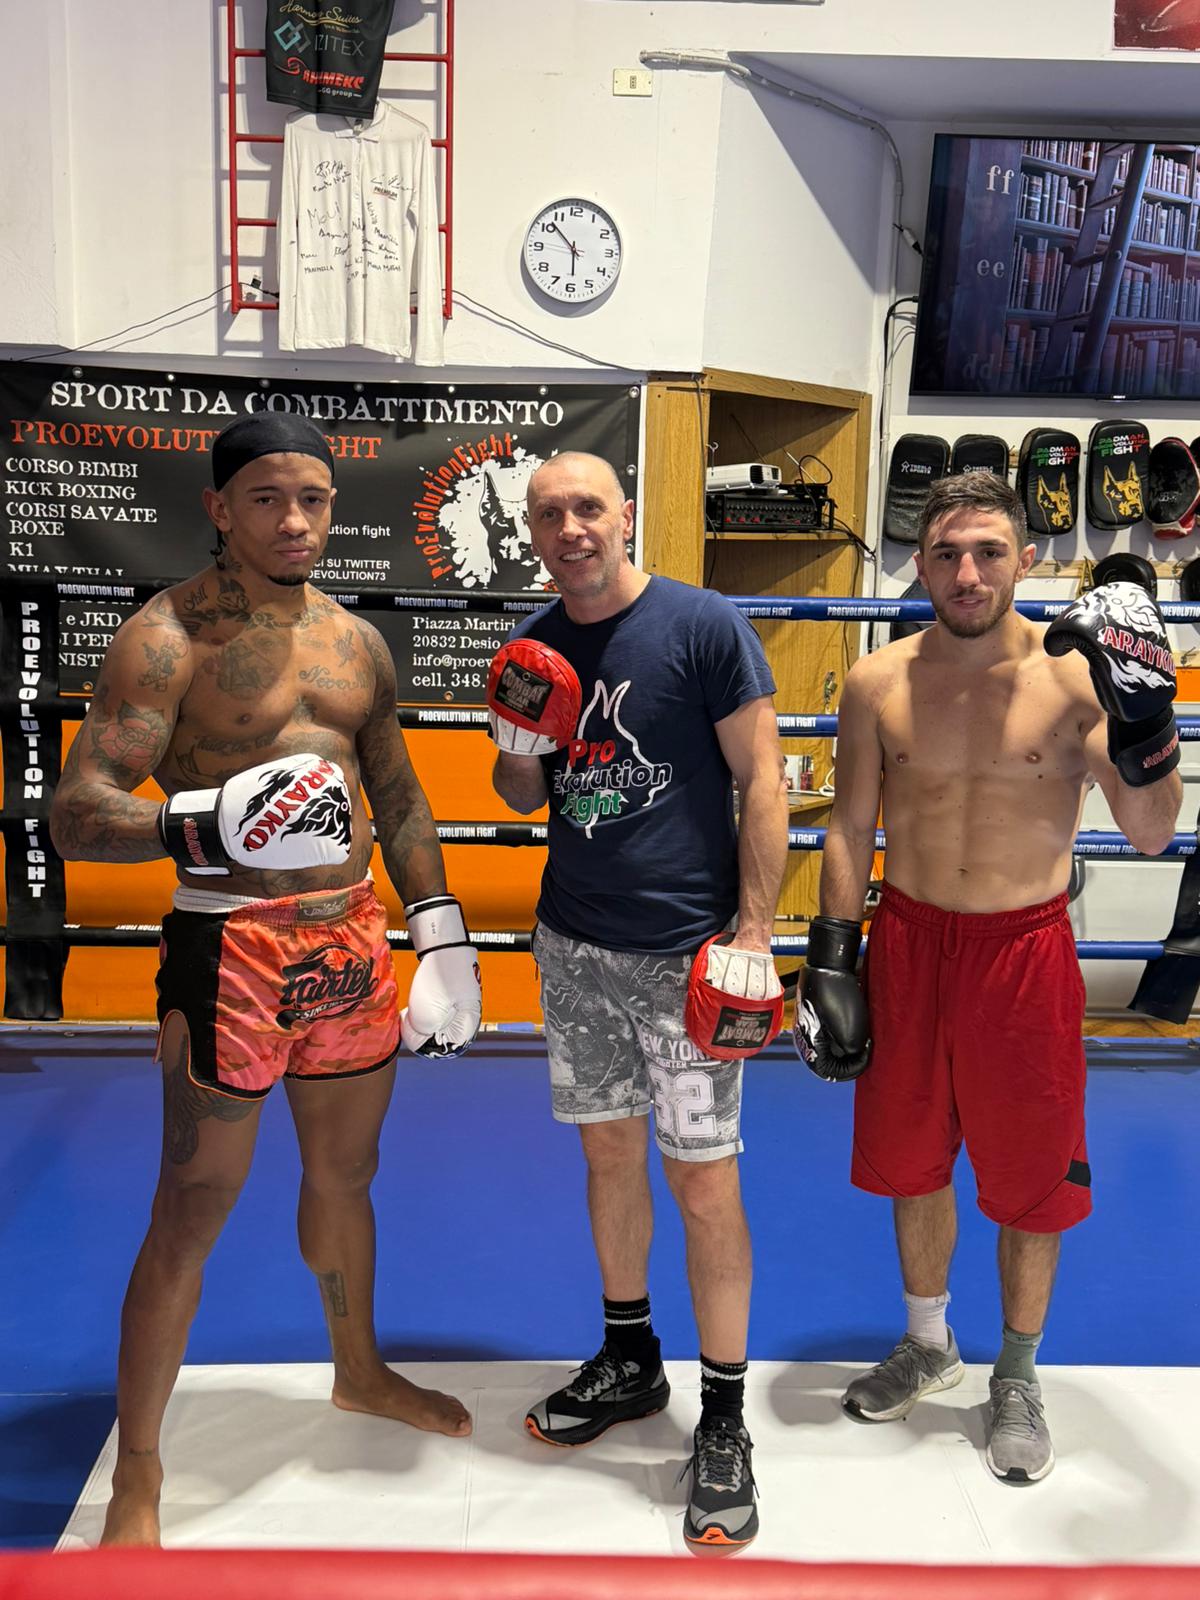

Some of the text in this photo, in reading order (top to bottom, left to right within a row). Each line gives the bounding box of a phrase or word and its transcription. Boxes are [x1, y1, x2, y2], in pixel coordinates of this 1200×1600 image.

[554, 212, 565, 222] 11
[570, 207, 583, 218] 12
[591, 214, 595, 224] 1
[541, 222, 556, 233] 10
[600, 229, 610, 240] 2
[533, 241, 544, 252] 9
[604, 248, 614, 258] 3
[538, 261, 549, 272] 8
[596, 266, 606, 277] 4
[976, 258, 1006, 279] ee
[551, 275, 561, 285] 7
[584, 279, 594, 289] 5
[565, 282, 576, 293] 6
[51, 381, 565, 427] SPORT DA COMBATTIMENTO
[1101, 444, 1142, 457] FIGHT
[5, 457, 139, 479] CORSO BIMBI
[1038, 457, 1074, 467] FIGHT
[5, 480, 137, 501] KICK BOXING
[6, 502, 158, 524] CORSI SAVATE
[9, 519, 65, 537] BOXE
[362, 525, 391, 539] fight
[9, 541, 35, 558] K1
[326, 559, 341, 569] SU
[344, 559, 391, 570] TWITTER
[57, 583, 135, 597] PROEVOLUTION FIGHT
[338, 594, 360, 604] FIGHT
[394, 596, 468, 609] PROEVOLUTION FIGHT
[772, 607, 793, 617] FIGHT
[827, 606, 901, 617] PROEVOLUTION FIGHT
[66, 611, 123, 627] e JKD
[412, 616, 516, 632] Piazza Martiri
[412, 635, 501, 650] 20832 Desio
[412, 672, 489, 689] cell. 348.
[418, 710, 471, 723] PROEVOLUTION
[796, 717, 817, 728] FIGHT
[18, 601, 46, 898] PROEVOLUTION FIGHT
[569, 738, 616, 768] Pro
[437, 826, 497, 838] EVOLUTION FIGHT
[532, 827, 548, 838] PRO
[797, 833, 818, 844] FIGHT
[279, 955, 379, 1006] Fairtex
[300, 1003, 328, 1020] SINCE
[716, 1023, 767, 1043] COMBAT
[667, 1039, 711, 1061] YOR
